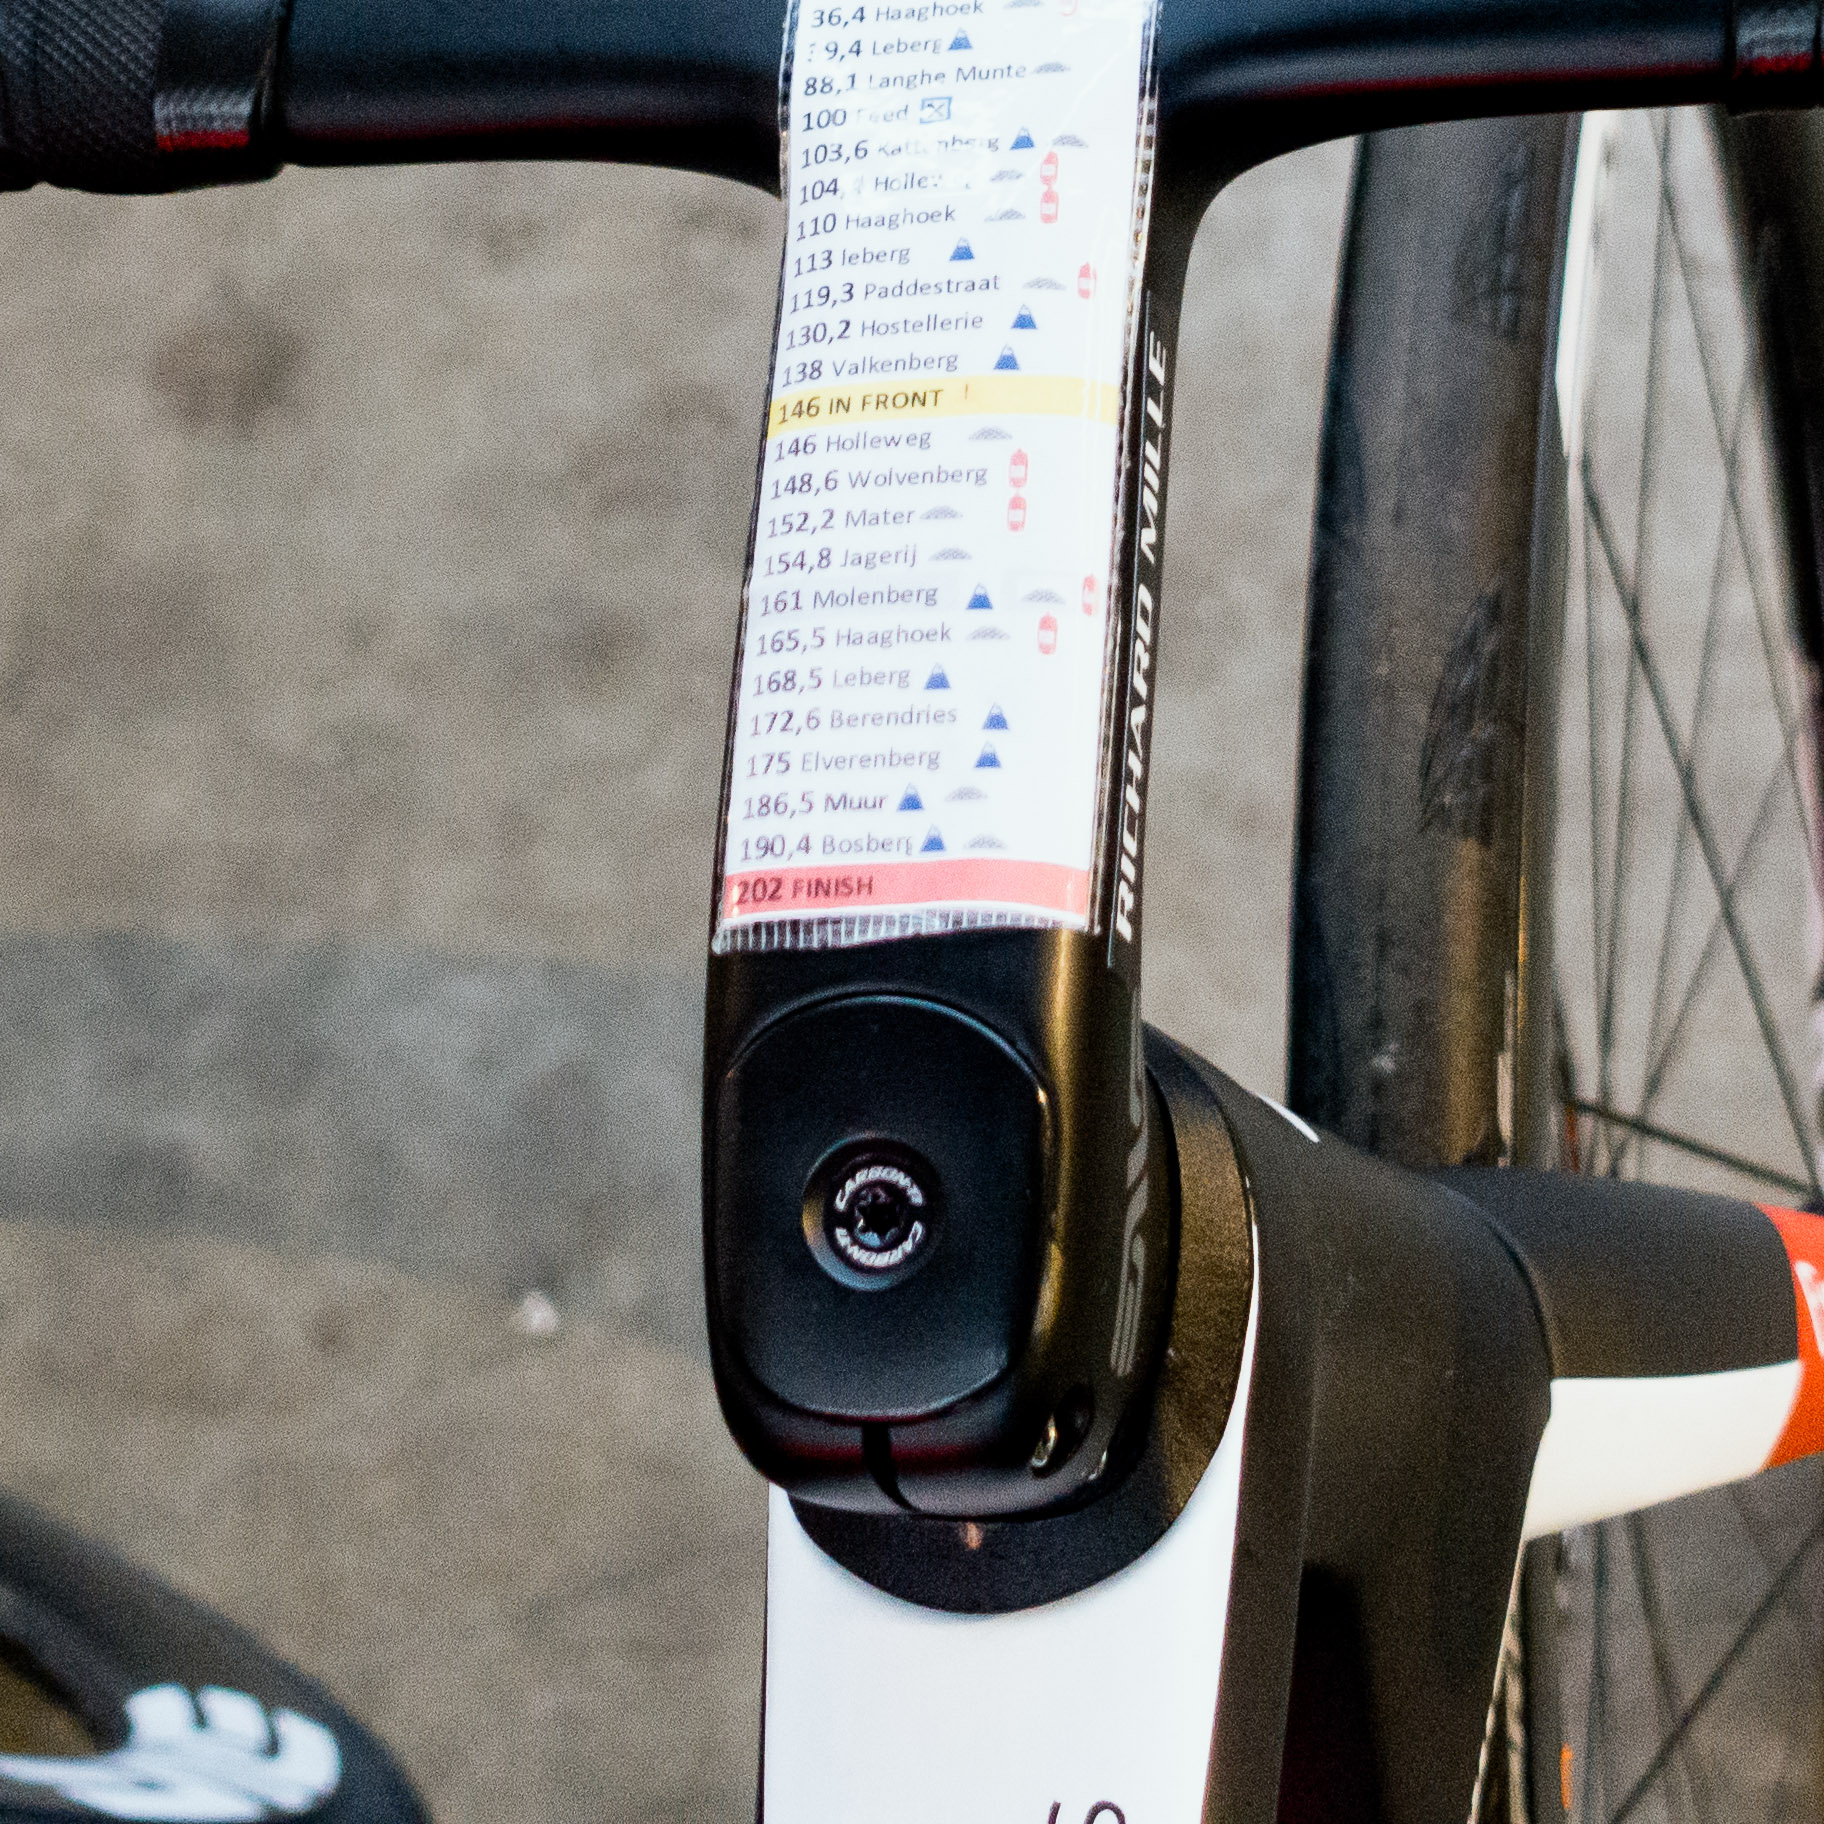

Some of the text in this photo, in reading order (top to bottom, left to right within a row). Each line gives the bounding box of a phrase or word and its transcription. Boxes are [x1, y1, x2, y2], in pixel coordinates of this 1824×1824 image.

[811, 5, 867, 29] 36,4
[803, 73, 857, 98] 88,1
[954, 64, 1028, 83] Munte
[801, 109, 847, 133] 100
[799, 139, 869, 169] 103,6
[795, 205, 956, 241] 110 Haaghoek
[793, 249, 833, 277] 113
[789, 275, 1000, 314] 119,3 Paddestraat
[786, 313, 984, 351] 130,2 Hostellerie
[781, 352, 959, 388] 138 Valkenberg
[778, 395, 820, 425] 146
[828, 395, 851, 415] IN
[861, 388, 944, 413] FRONT
[773, 429, 932, 463] 146 Holleweg
[771, 464, 988, 501] 148,6 Wolvenberg
[767, 507, 916, 539] 152,2 Mater
[764, 545, 919, 577] 154,8 Jagerij
[760, 584, 938, 618] 161 Molenberg
[756, 621, 953, 657] 165,5 Haaghoek
[1115, 330, 1167, 943] RICHARD MILLE
[752, 667, 911, 697] 168,5 Leberg
[749, 704, 958, 739] 172,6 Berendries
[746, 747, 942, 778] 175 Elverenberg
[742, 792, 888, 822] 186,5 Muur
[738, 833, 813, 863] 190,4
[735, 874, 874, 906] 202 FINISH
